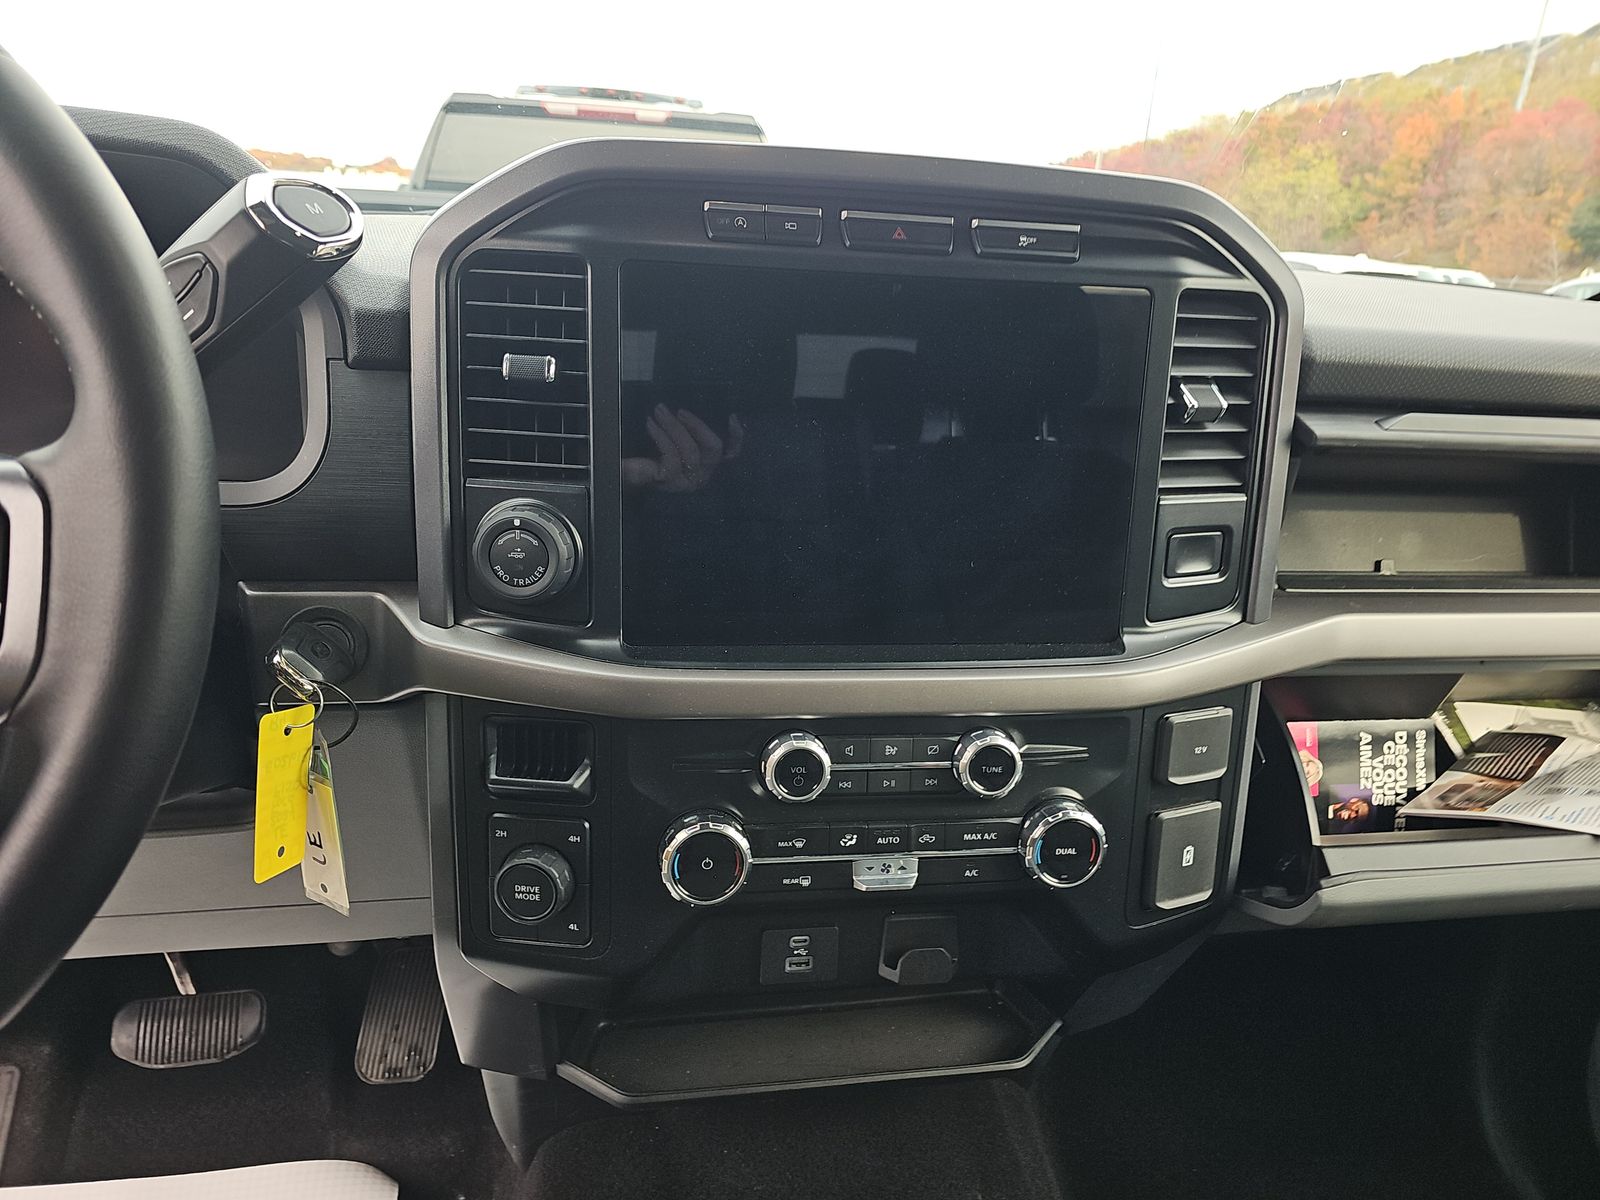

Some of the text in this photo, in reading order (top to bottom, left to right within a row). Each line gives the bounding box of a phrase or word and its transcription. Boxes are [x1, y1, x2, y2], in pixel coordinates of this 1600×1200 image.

[305, 202, 324, 215] M
[493, 565, 546, 586] PRO TRAILER
[1194, 745, 1208, 754] 12V
[1359, 731, 1372, 790] AIMEZ
[790, 766, 807, 774] VOL
[1383, 740, 1396, 807] CE QUE
[1371, 755, 1384, 806] VOUS
[495, 829, 507, 838] 2H
[963, 832, 998, 841] MAX A/C
[567, 835, 580, 843] 4H
[876, 836, 900, 844] AUTO
[964, 869, 980, 877] A/C
[514, 885, 541, 893] DRIVE
[514, 892, 541, 901] MODE
[568, 923, 580, 931] 4L
